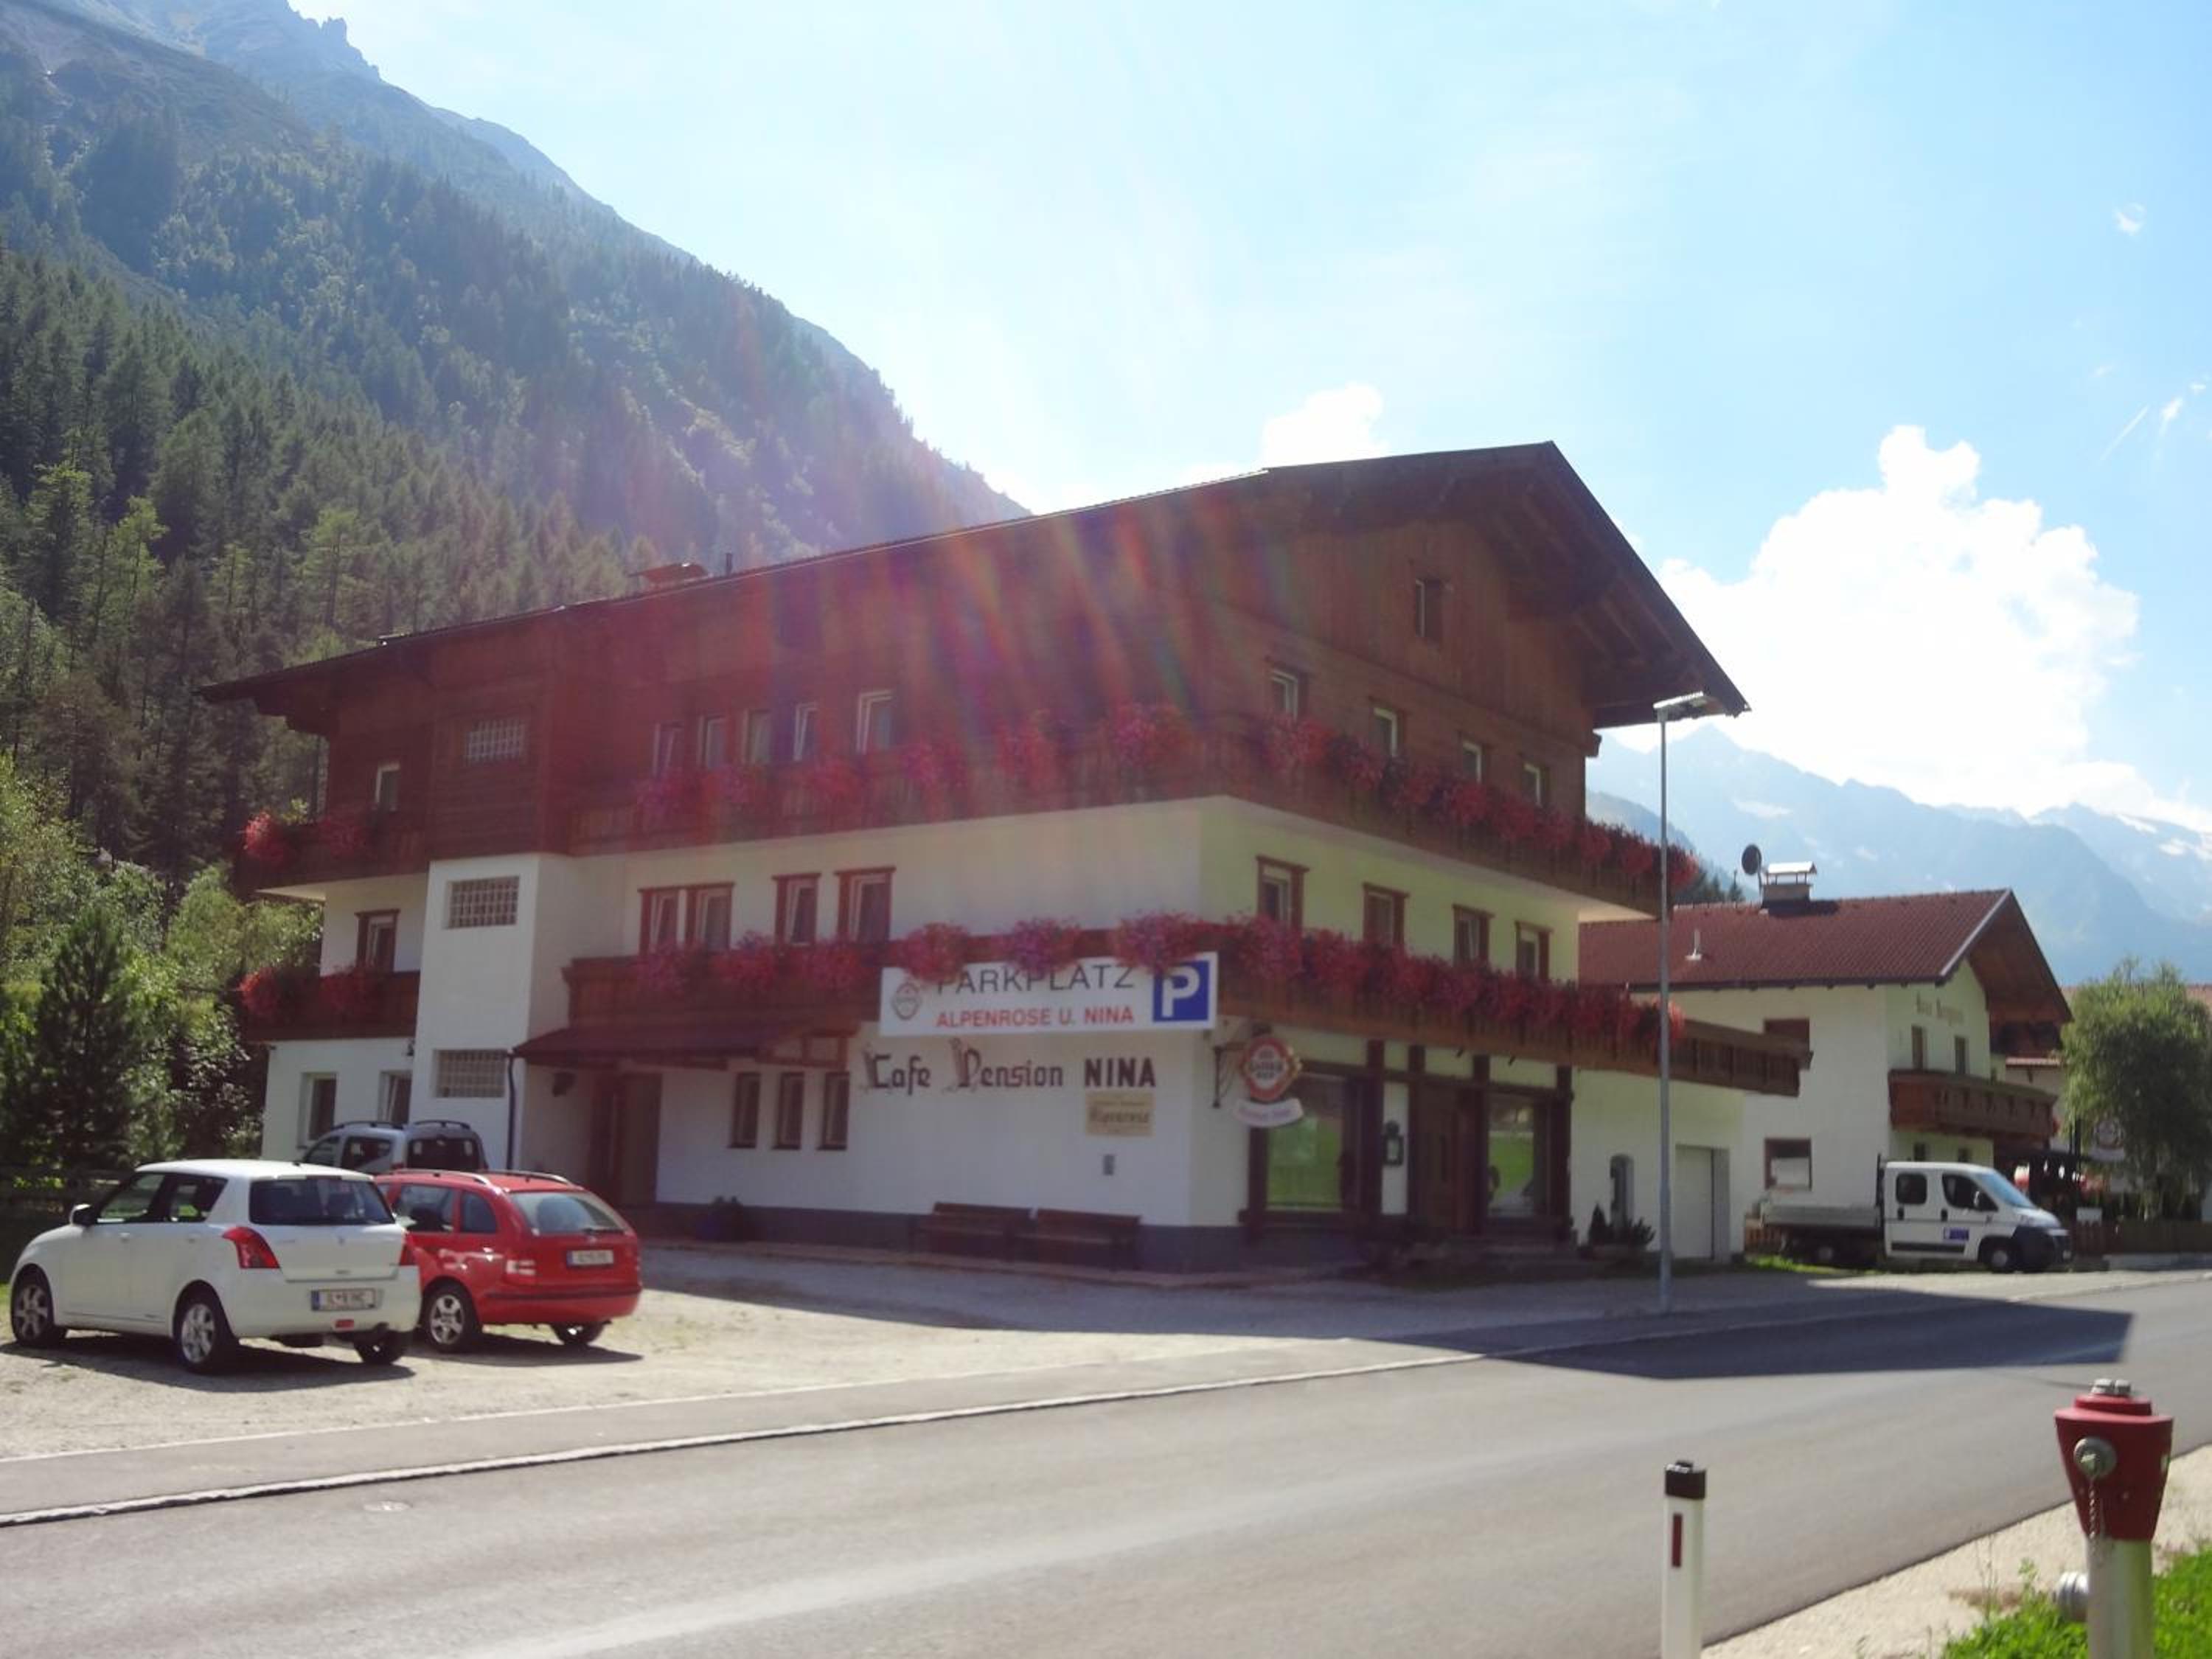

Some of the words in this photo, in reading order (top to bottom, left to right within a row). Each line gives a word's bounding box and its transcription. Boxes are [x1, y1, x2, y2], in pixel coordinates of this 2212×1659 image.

[936, 1007, 1051, 1028] ALPENROSE
[1084, 1005, 1134, 1024] NINA
[1161, 966, 1199, 1018] P
[951, 1039, 1062, 1091] Pension
[1085, 1057, 1156, 1088] NINA
